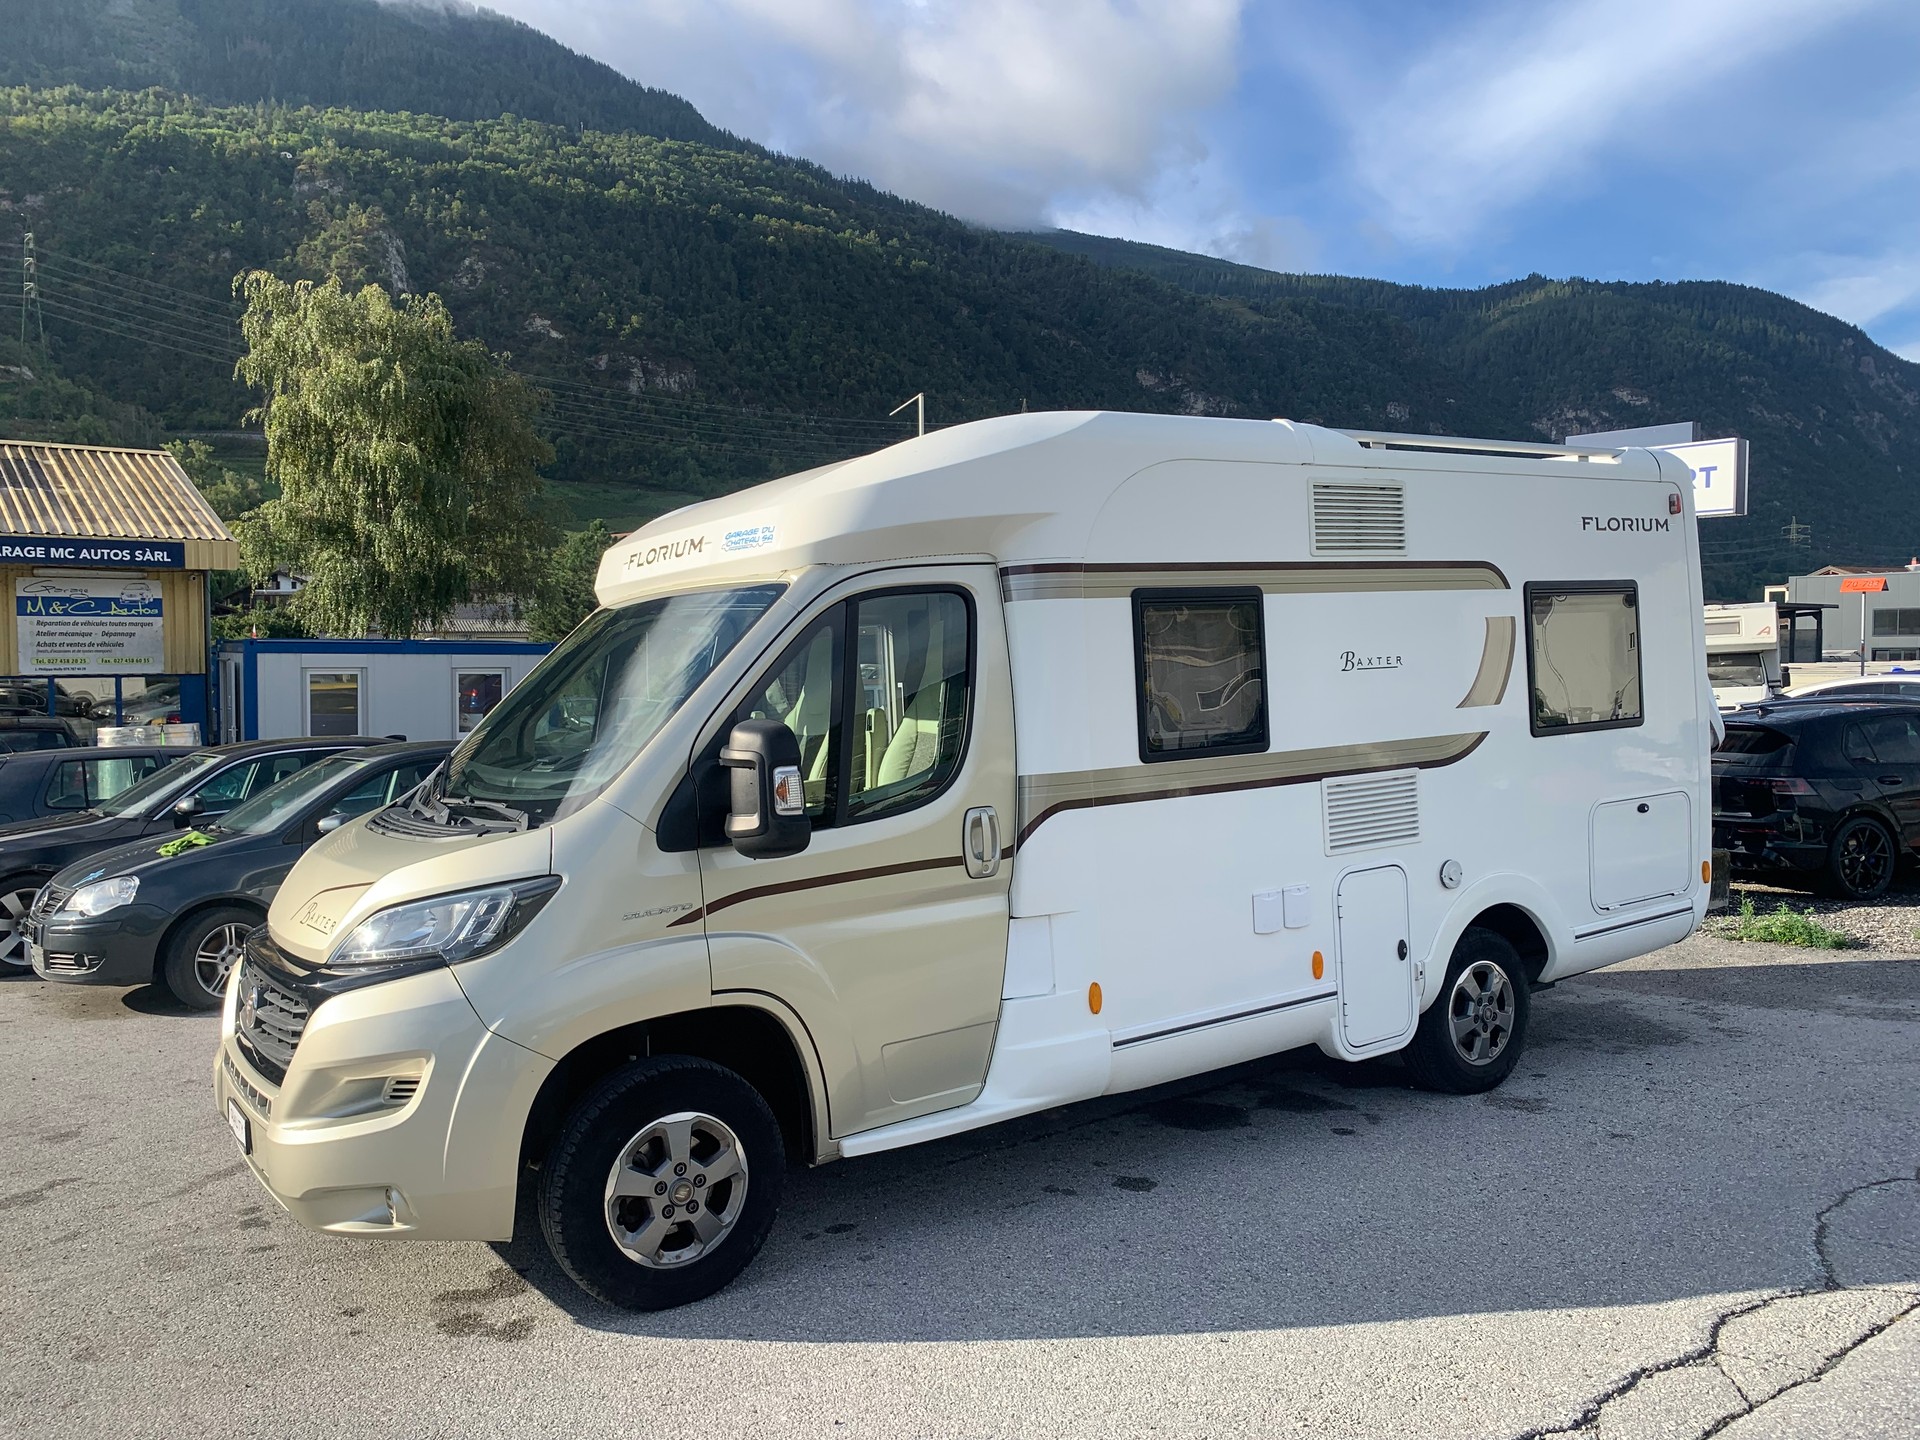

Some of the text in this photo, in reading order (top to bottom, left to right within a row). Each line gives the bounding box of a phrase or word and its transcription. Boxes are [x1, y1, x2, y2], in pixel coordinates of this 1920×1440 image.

[1581, 516, 1669, 532] FLORIUM
[725, 525, 776, 540] GARAGE DU
[761, 533, 774, 542] SA
[0, 545, 172, 562] RAGE MC AUTOS SÀRL
[627, 535, 705, 570] FLORIUM
[23, 579, 89, 600] Garage
[27, 596, 46, 615] M
[101, 601, 159, 616] Autos
[36, 619, 71, 627] Réparation
[128, 621, 154, 629] marques
[58, 630, 93, 638] mécanique
[101, 630, 137, 639] Dépannage
[96, 640, 125, 648] véhicules
[1340, 650, 1403, 672] BAXTER
